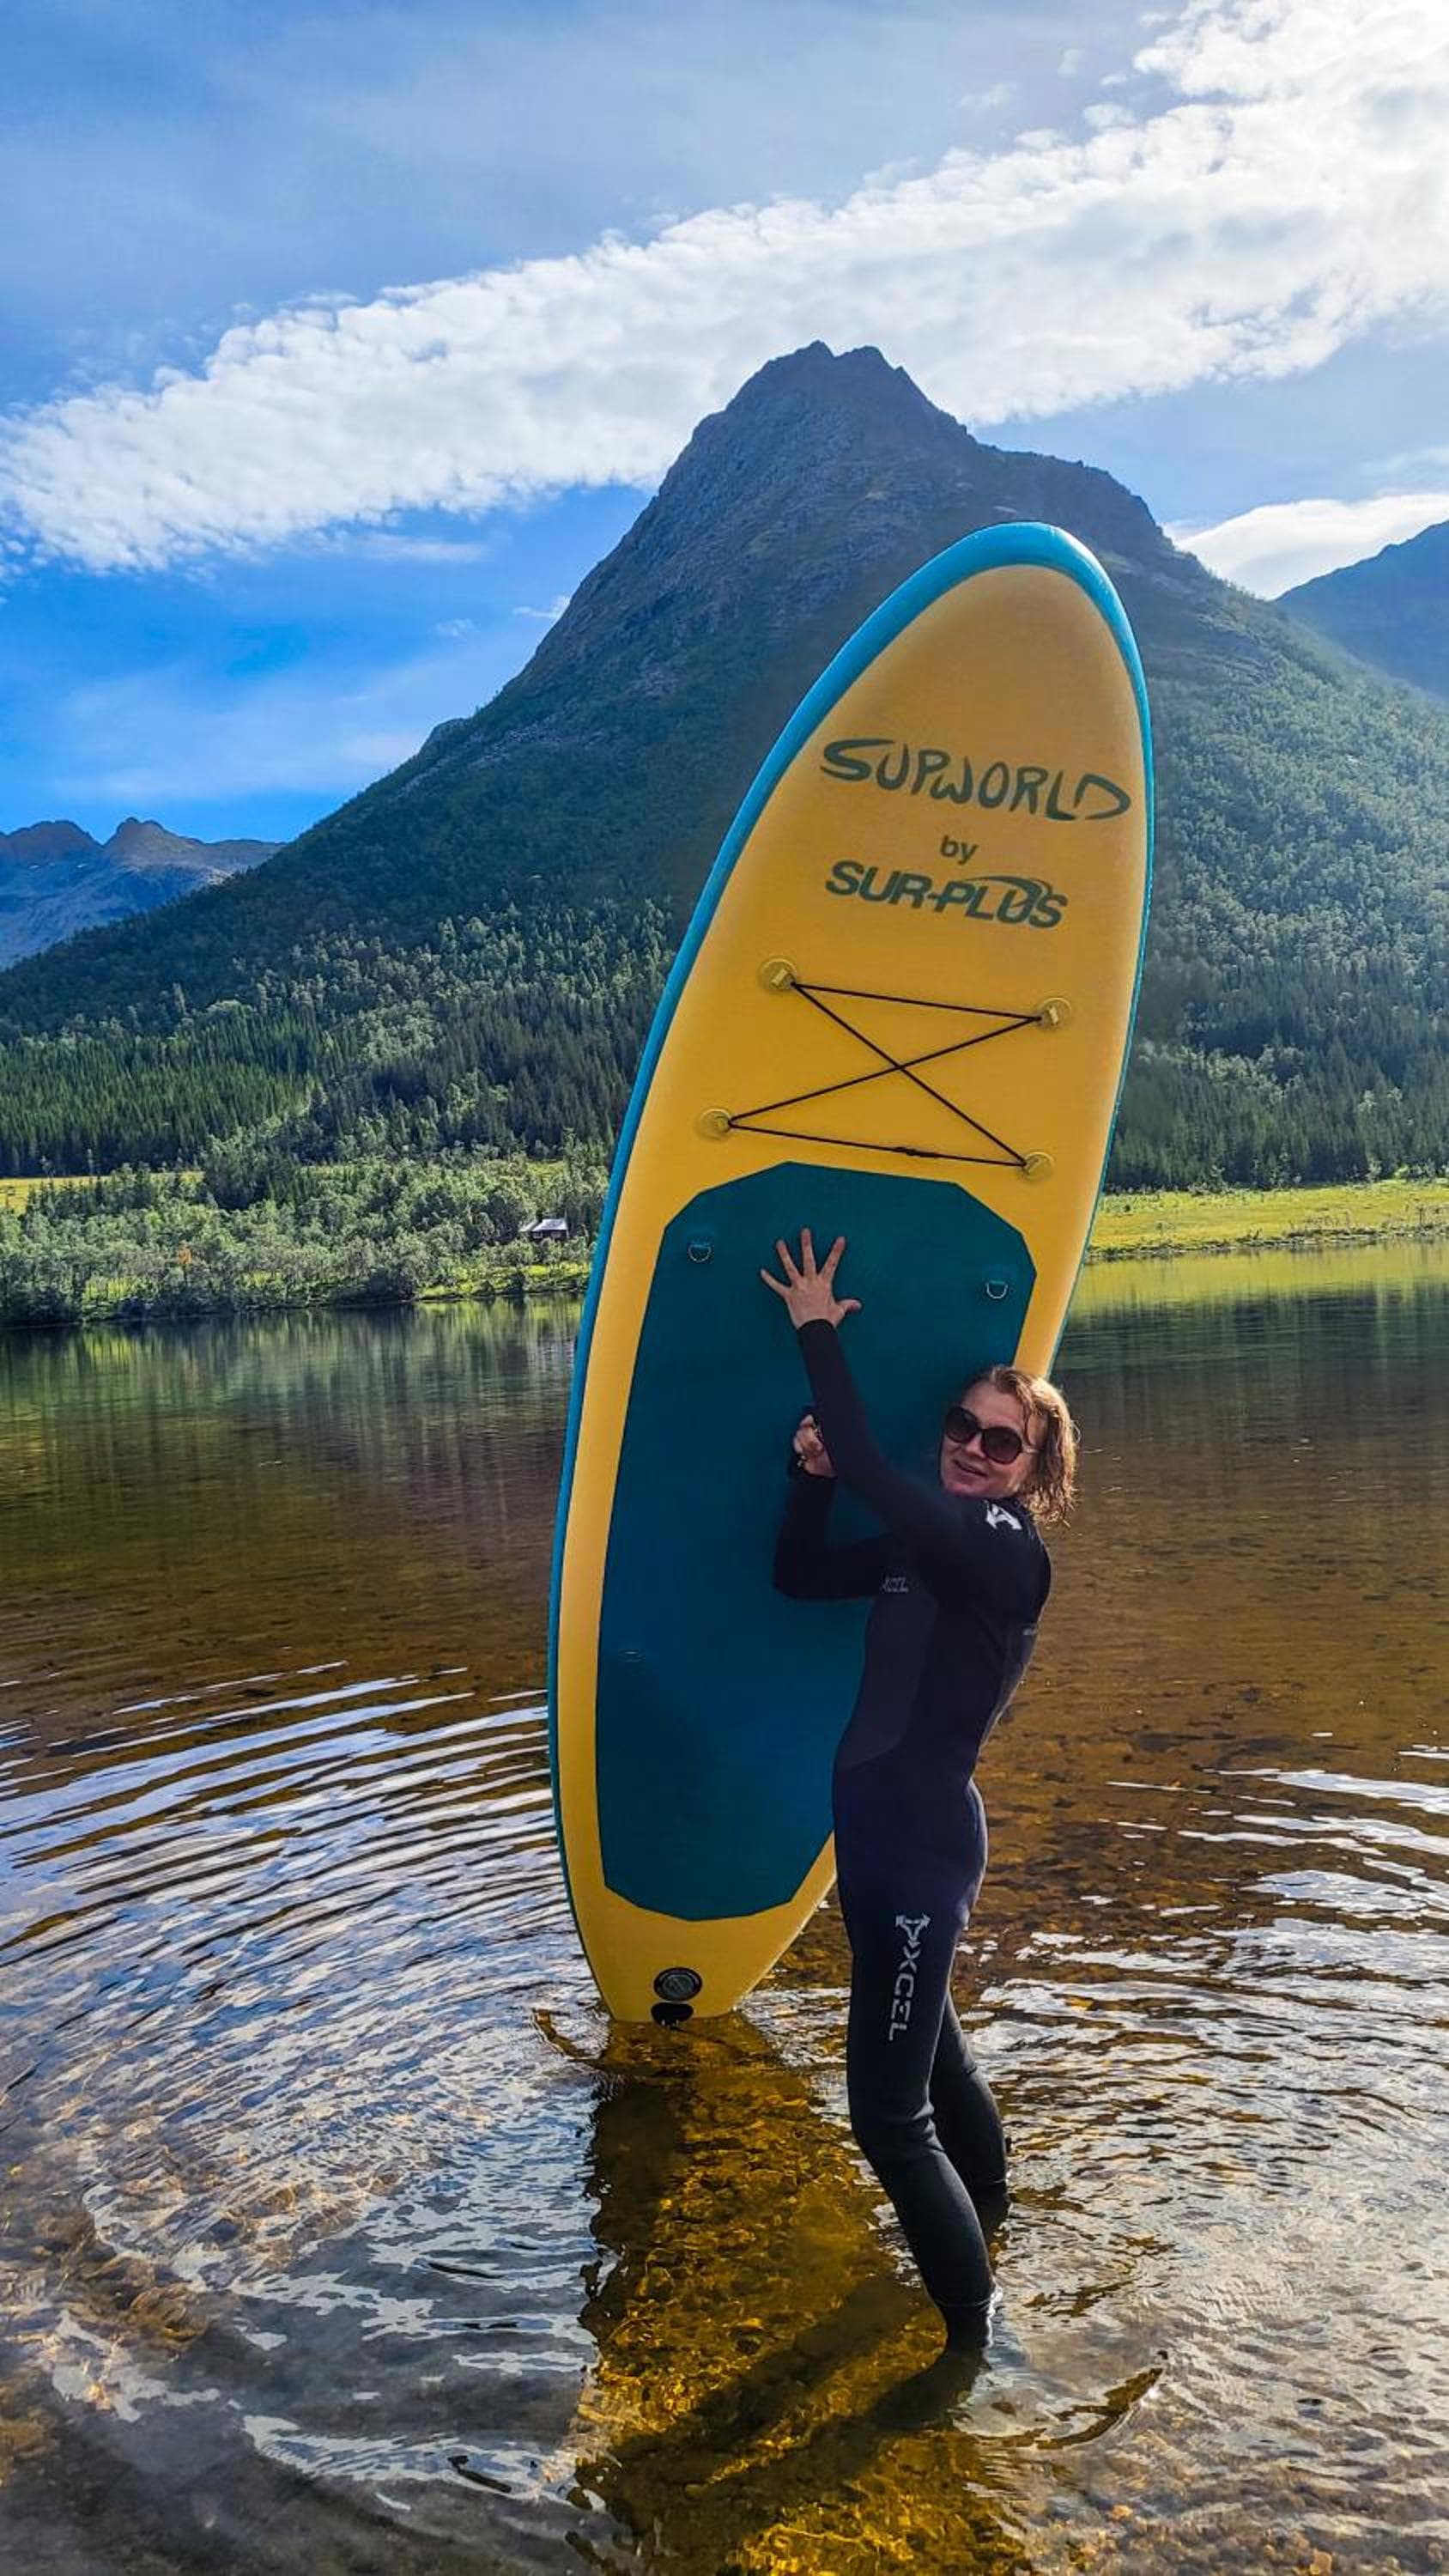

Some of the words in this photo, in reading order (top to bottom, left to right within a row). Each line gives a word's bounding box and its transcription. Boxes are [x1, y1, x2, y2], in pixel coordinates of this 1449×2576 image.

[821, 738, 1131, 821] SUPWORLD
[939, 835, 979, 865] by
[888, 1946, 921, 2041] XCEL
